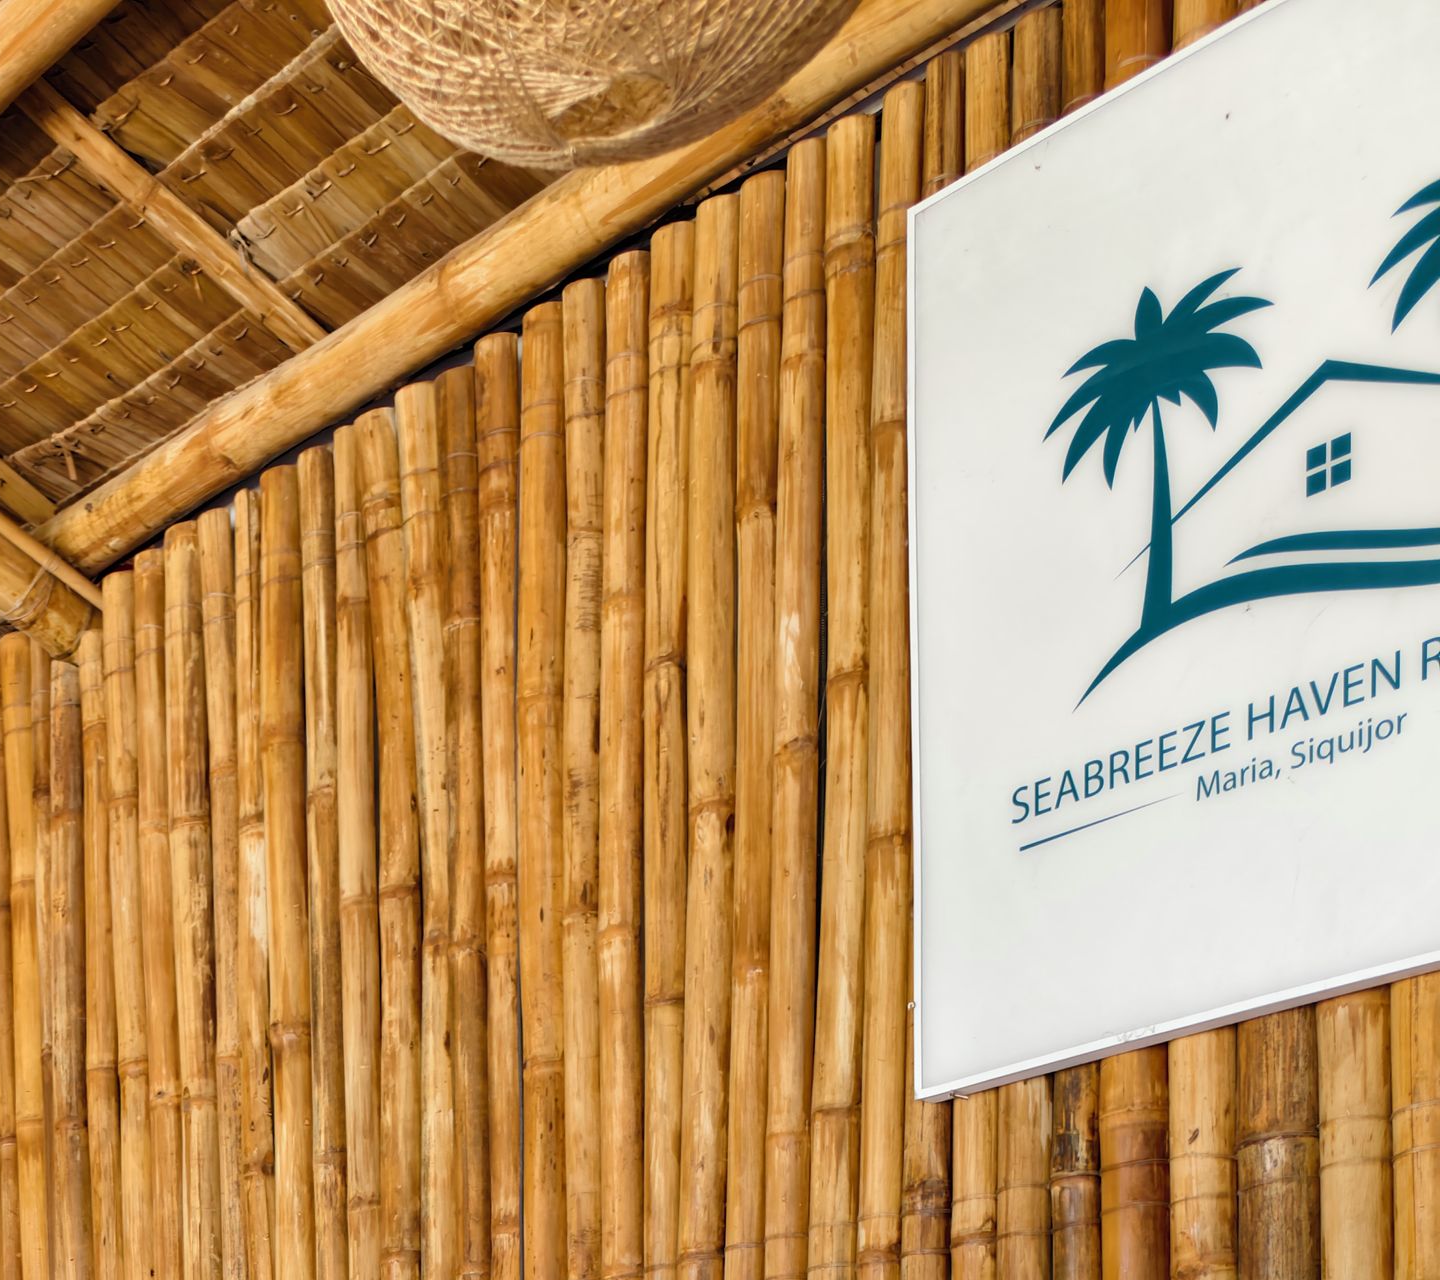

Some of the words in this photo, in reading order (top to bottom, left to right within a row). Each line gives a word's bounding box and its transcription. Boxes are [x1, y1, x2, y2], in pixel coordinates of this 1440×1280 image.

[1012, 711, 1230, 824] SEABREEZE
[1247, 650, 1401, 740] HAVEN
[1195, 758, 1282, 802] Maria,
[1290, 712, 1408, 770] Siquijor
